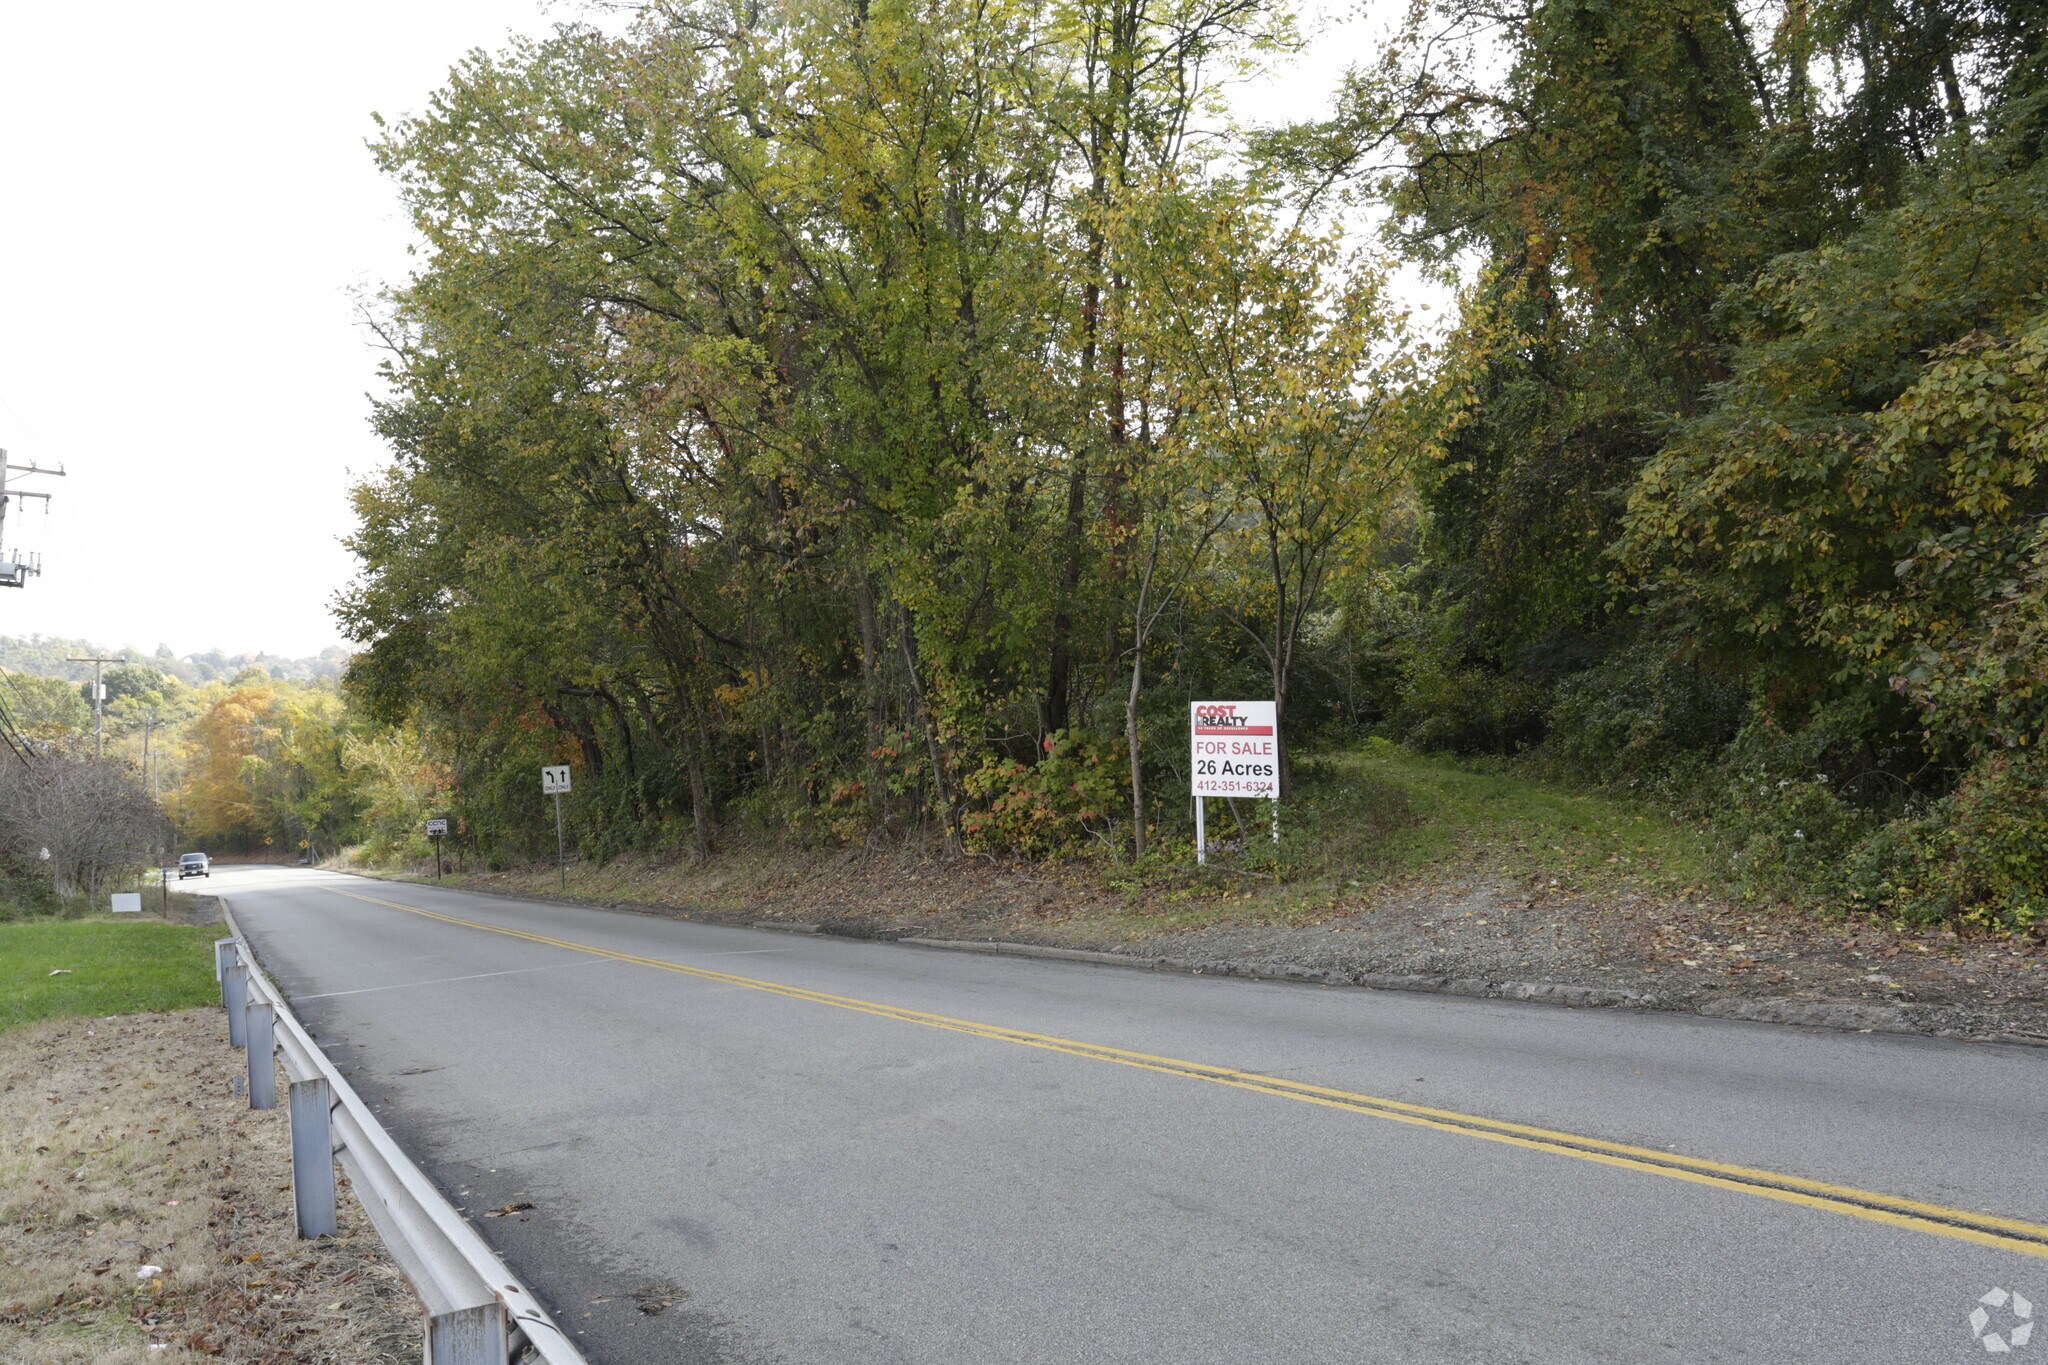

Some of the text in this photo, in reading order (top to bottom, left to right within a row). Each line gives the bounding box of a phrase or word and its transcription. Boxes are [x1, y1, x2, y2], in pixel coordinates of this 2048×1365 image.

[1196, 705, 1236, 717] COST
[1203, 716, 1247, 726] REALTY
[1196, 742, 1272, 755] FOR SALE
[1197, 760, 1273, 776] 26 Acres
[1197, 781, 1273, 792] 412-351-6324
